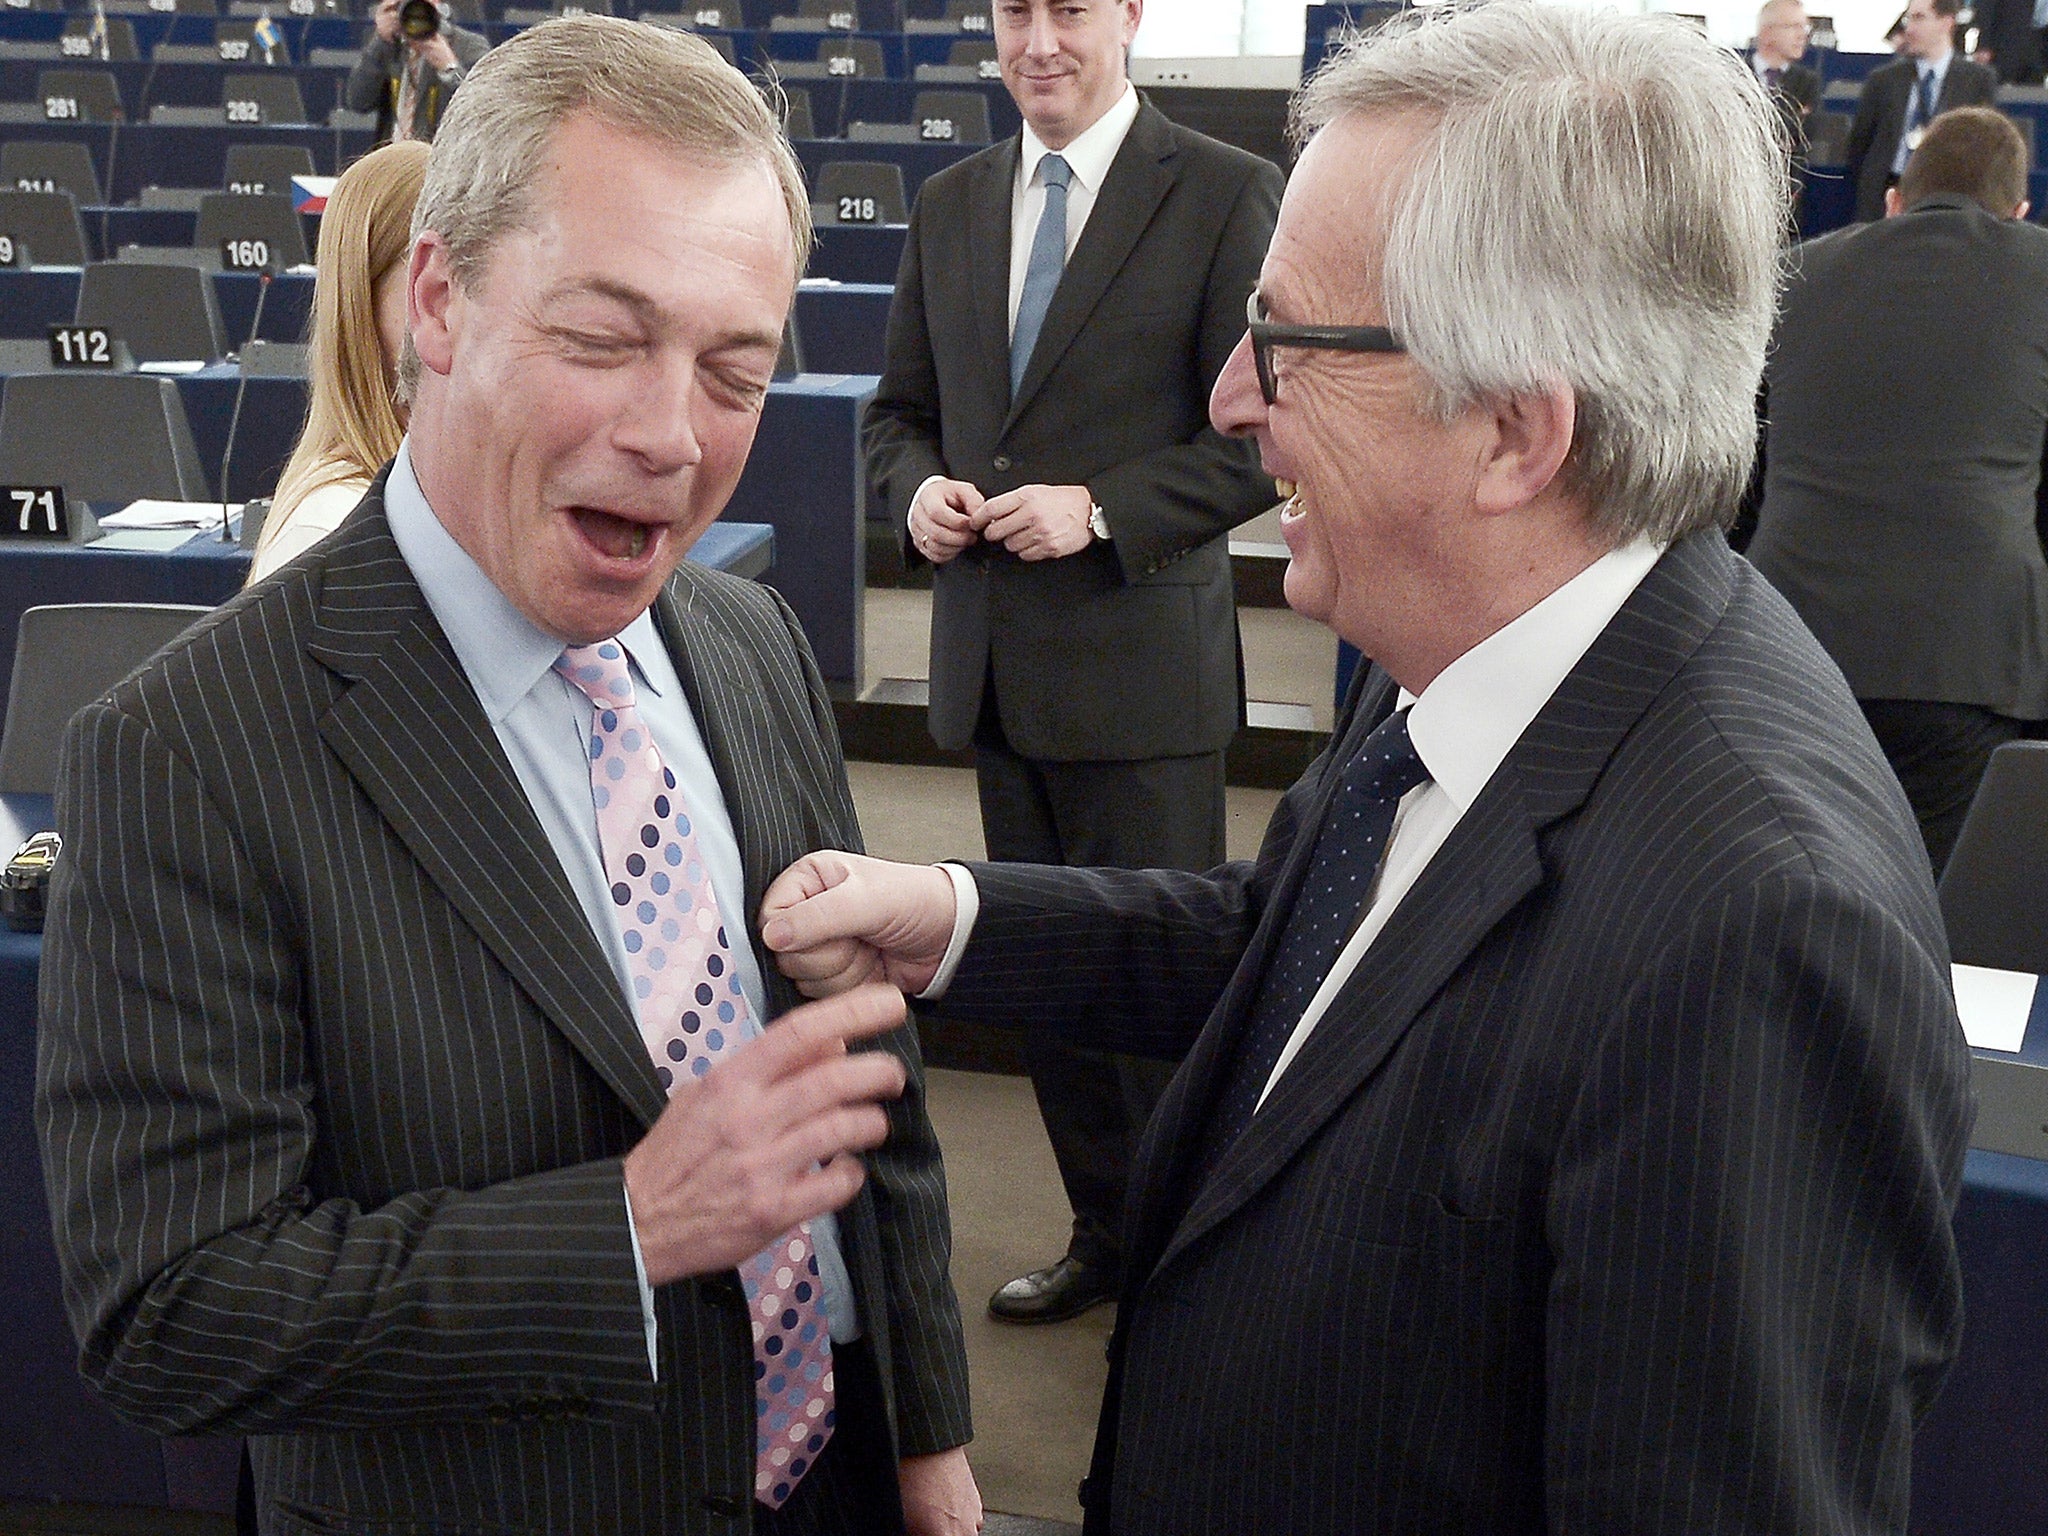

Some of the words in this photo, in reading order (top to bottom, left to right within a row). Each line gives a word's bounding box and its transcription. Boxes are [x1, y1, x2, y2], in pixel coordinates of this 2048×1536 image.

[840, 197, 875, 219] 218
[226, 240, 267, 266] 160
[56, 330, 110, 362] 112
[10, 491, 57, 531] 71
